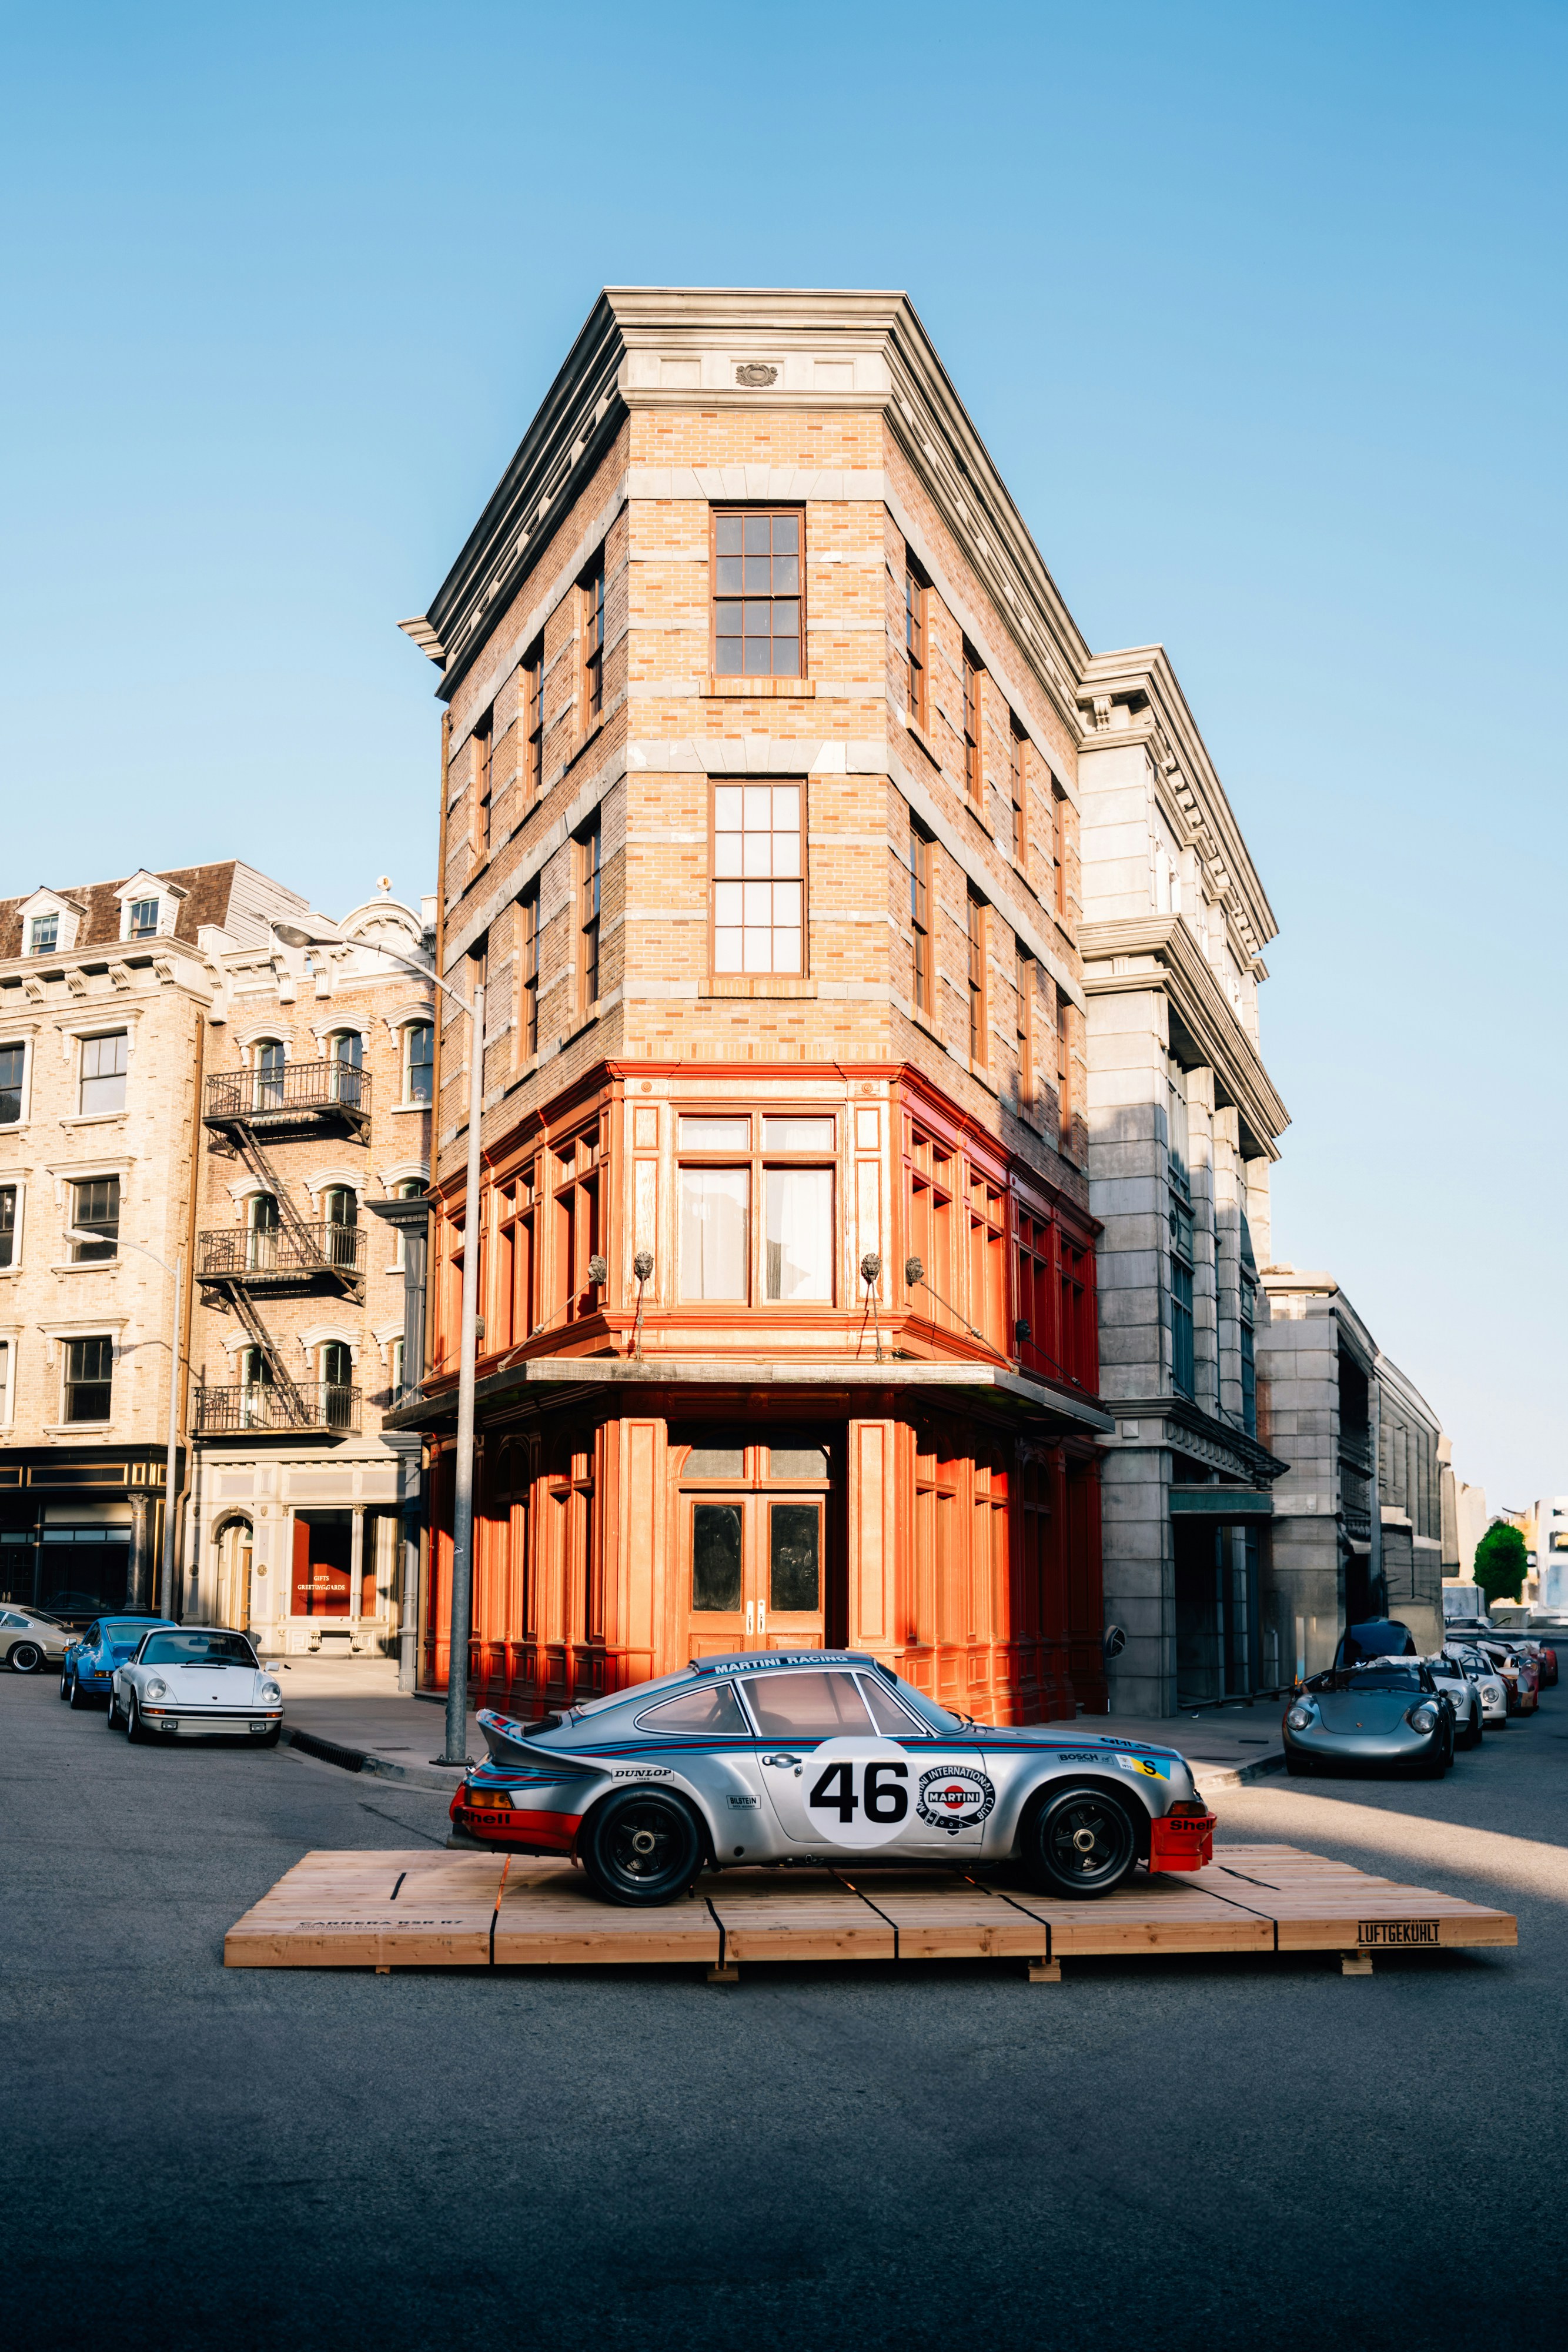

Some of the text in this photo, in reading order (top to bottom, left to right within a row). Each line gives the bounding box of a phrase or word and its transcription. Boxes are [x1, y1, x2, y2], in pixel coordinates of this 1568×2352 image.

[714, 1656, 848, 1674] MARTINI RACING
[1142, 1760, 1156, 1775] S
[810, 1758, 908, 1823] 46
[928, 1766, 993, 1795] INTERNATIONAL
[977, 1797, 994, 1819] CLUB
[929, 1793, 979, 1802] MARTINI
[462, 1810, 510, 1824] Shell
[1170, 1819, 1213, 1830] Shell
[1358, 1920, 1440, 1943] LUFTGEKÜHLT
